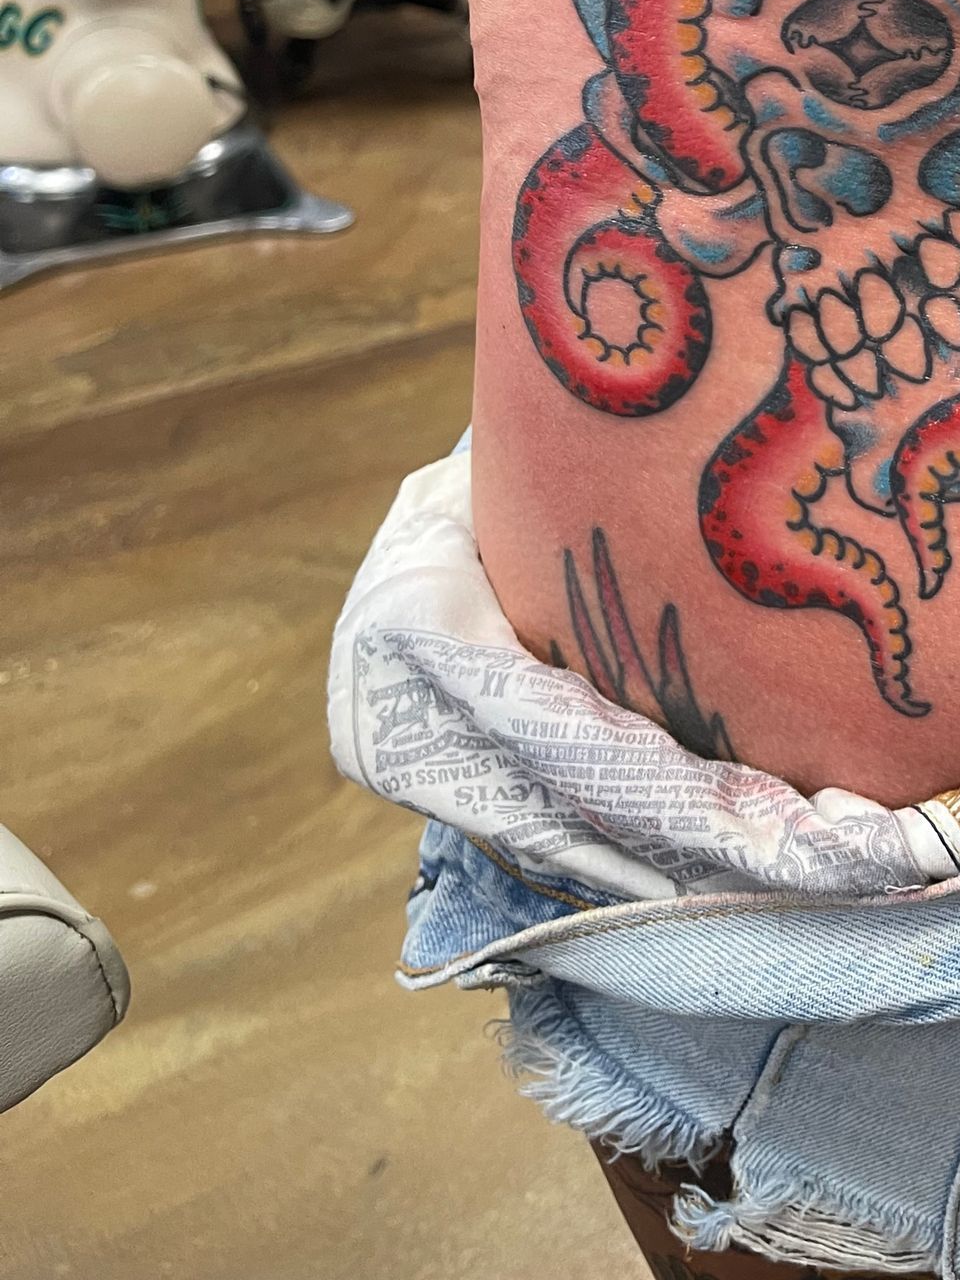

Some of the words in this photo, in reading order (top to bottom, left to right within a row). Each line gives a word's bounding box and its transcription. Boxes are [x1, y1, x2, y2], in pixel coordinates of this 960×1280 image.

[438, 663, 458, 679] also
[458, 666, 481, 680] and
[479, 670, 511, 698] XX
[516, 674, 527, 687] is
[528, 677, 564, 694] which
[574, 723, 668, 747] STRONGEST
[551, 747, 589, 761] COTTON
[400, 771, 413, 789] &
[414, 758, 493, 786] STRAUSS
[375, 776, 401, 796] CO.
[584, 785, 594, 797] in
[597, 785, 622, 798] used
[624, 785, 653, 799] been
[654, 785, 682, 799] have
[453, 781, 555, 817] Levi's
[614, 795, 667, 815] durability
[667, 800, 686, 815] for
